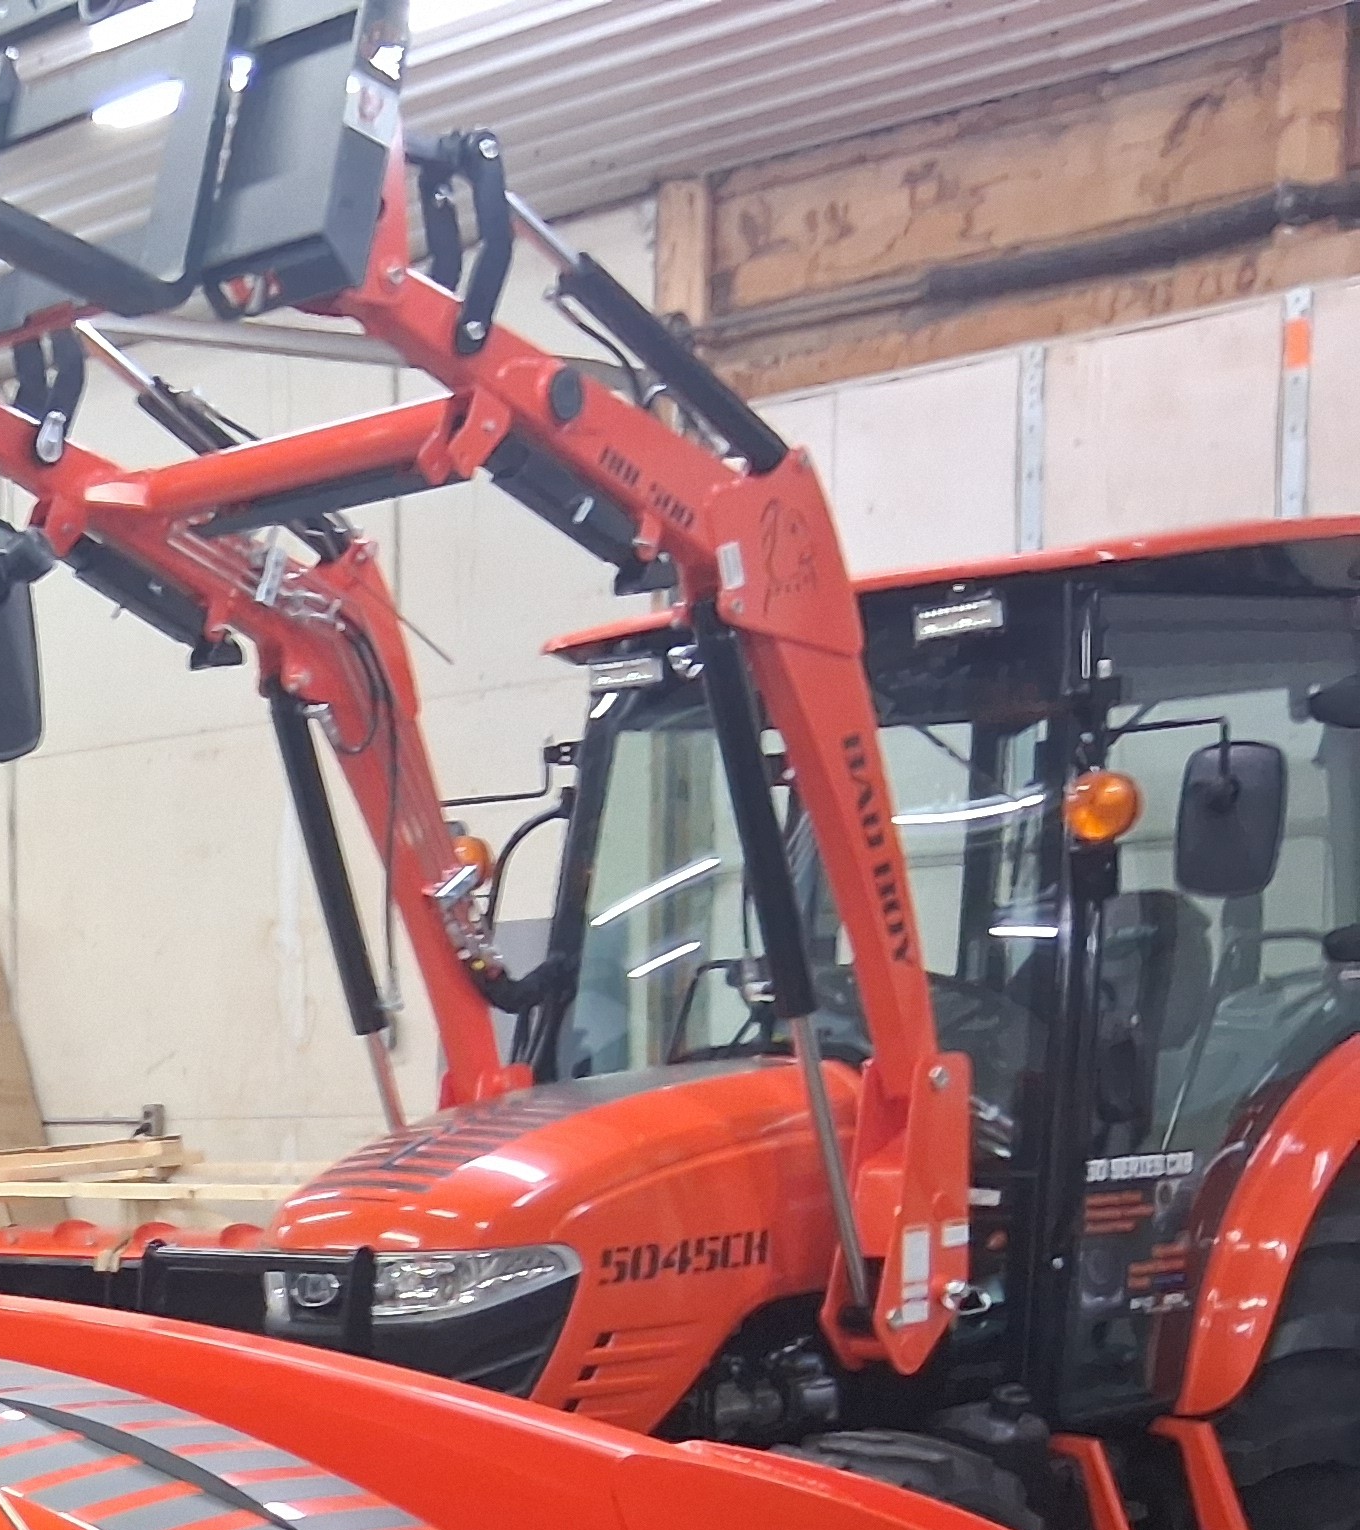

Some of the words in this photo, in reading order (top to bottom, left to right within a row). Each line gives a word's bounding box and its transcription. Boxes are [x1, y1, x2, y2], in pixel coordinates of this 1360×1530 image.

[843, 733, 885, 848] BAD
[874, 863, 920, 968] BOY
[598, 1229, 769, 1286] 5045CH
